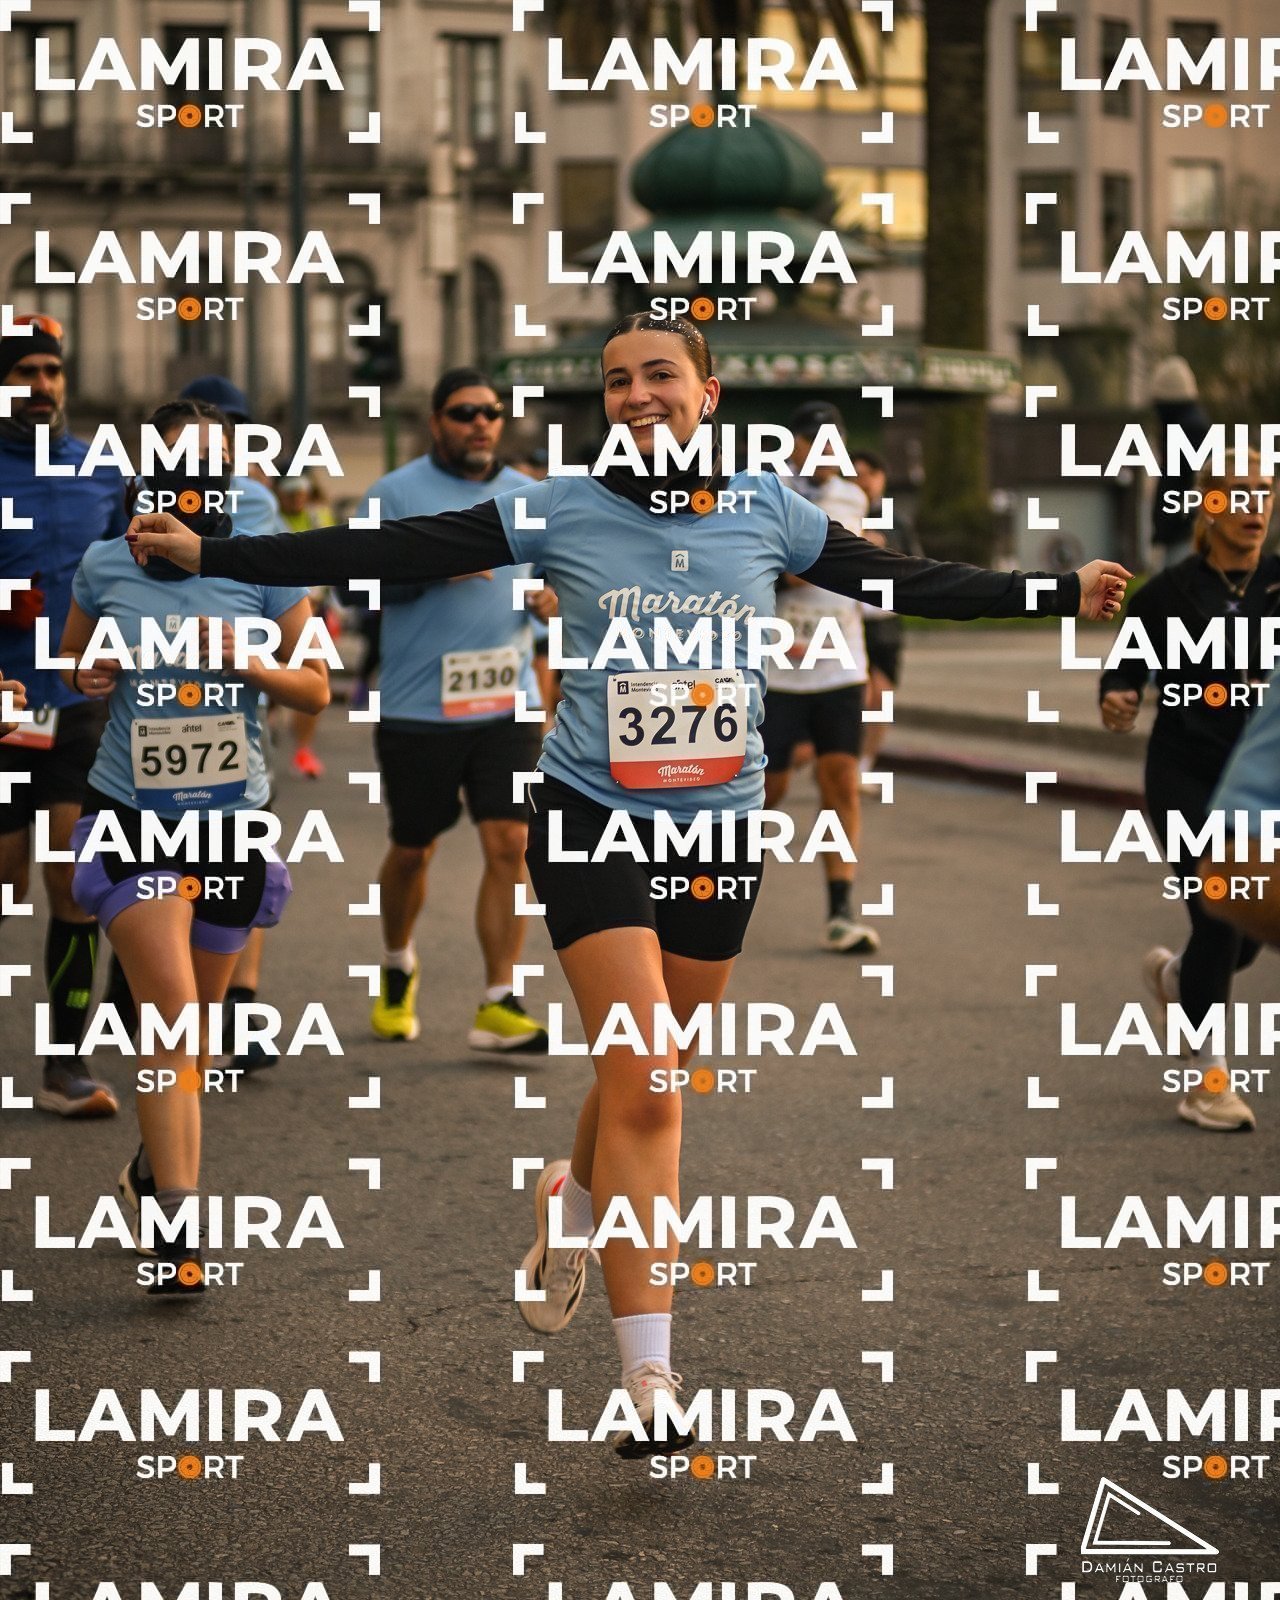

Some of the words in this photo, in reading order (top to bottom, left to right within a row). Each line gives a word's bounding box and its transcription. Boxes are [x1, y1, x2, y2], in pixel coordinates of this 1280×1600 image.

[598, 585, 756, 625] Maratón
[449, 666, 515, 692] 2130
[181, 723, 202, 733] antel
[618, 703, 738, 747] 3276
[141, 740, 239, 776] 5972
[657, 764, 705, 778] Maratón
[172, 790, 213, 801] Maratón
